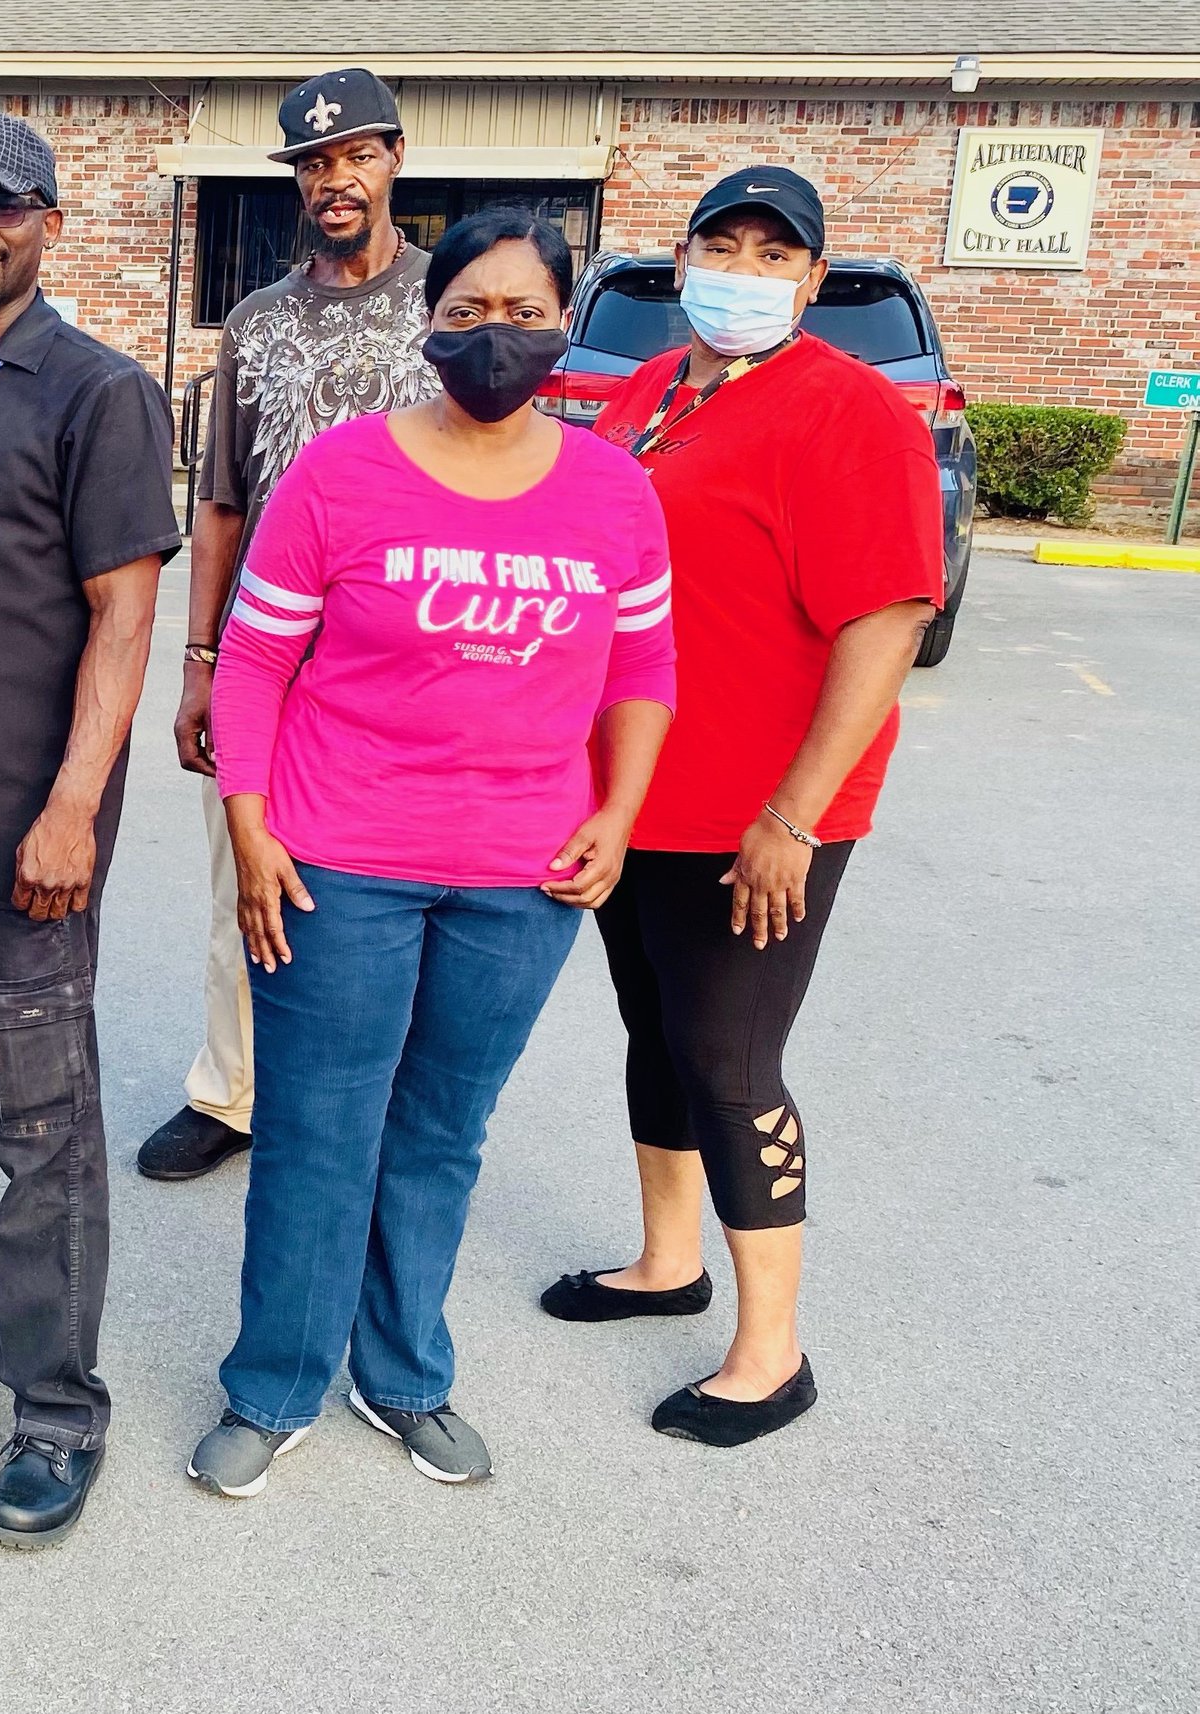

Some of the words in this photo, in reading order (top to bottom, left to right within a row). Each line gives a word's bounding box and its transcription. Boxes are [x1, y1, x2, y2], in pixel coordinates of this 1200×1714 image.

[969, 143, 1087, 175] ALTHEIMER
[963, 227, 1011, 253] CITY
[1016, 230, 1072, 254] HALL
[1155, 374, 1193, 389] CLERK
[385, 547, 415, 583] IN
[422, 547, 488, 586] PINK
[495, 552, 551, 592] FOR
[552, 557, 606, 594] THE
[416, 576, 580, 635] Cure
[452, 641, 496, 654] susan
